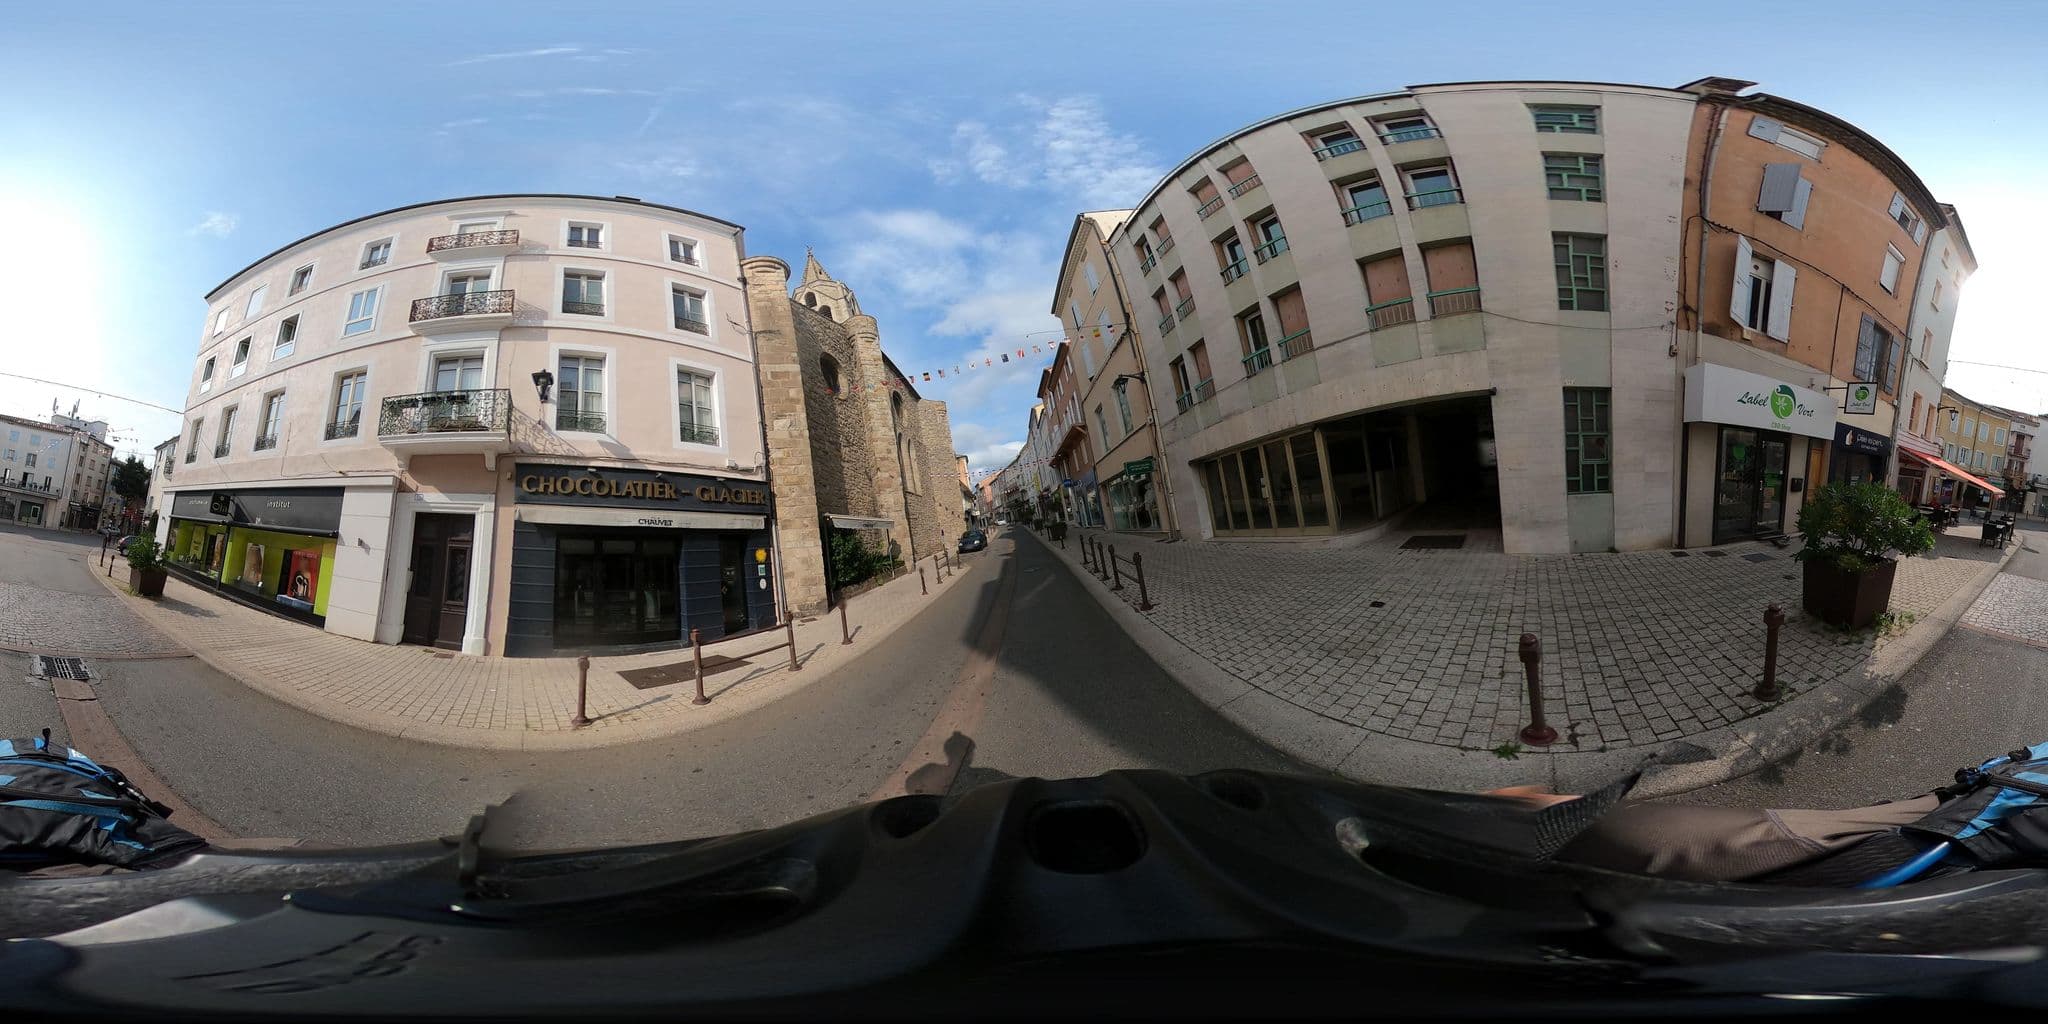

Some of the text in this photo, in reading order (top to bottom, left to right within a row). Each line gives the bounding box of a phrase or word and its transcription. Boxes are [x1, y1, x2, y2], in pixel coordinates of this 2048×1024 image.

[1737, 391, 1814, 417] Label Vert
[522, 475, 677, 499] CHOCOLATIER
[695, 485, 767, 504] GLACIER
[266, 499, 291, 509] institut
[638, 517, 673, 525] CHAUVET
